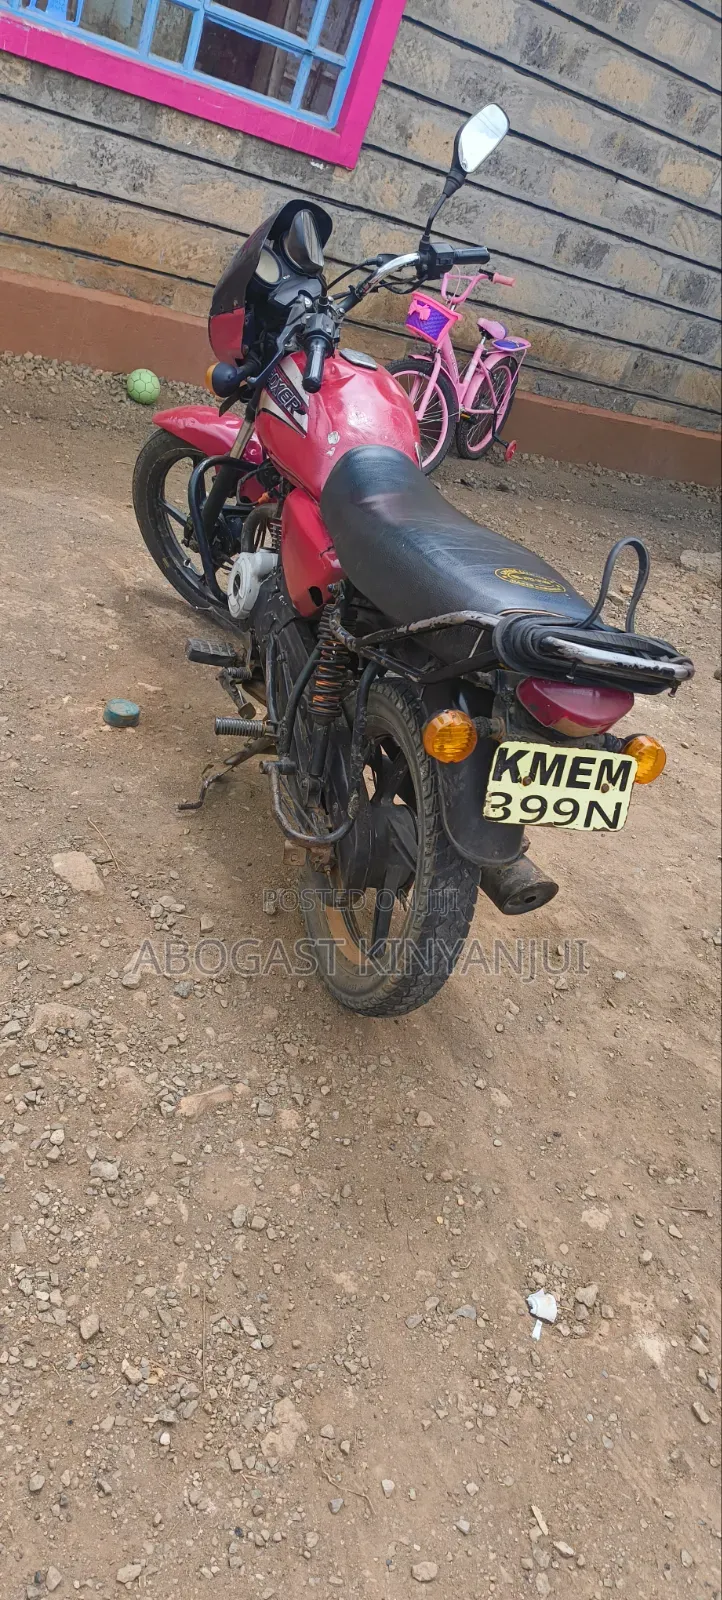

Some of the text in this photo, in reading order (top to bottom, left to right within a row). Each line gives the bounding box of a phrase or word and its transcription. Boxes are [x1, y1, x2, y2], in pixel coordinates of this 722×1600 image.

[267, 370, 303, 415] OXER
[491, 747, 633, 793] KMEM
[484, 791, 623, 830] 399N
